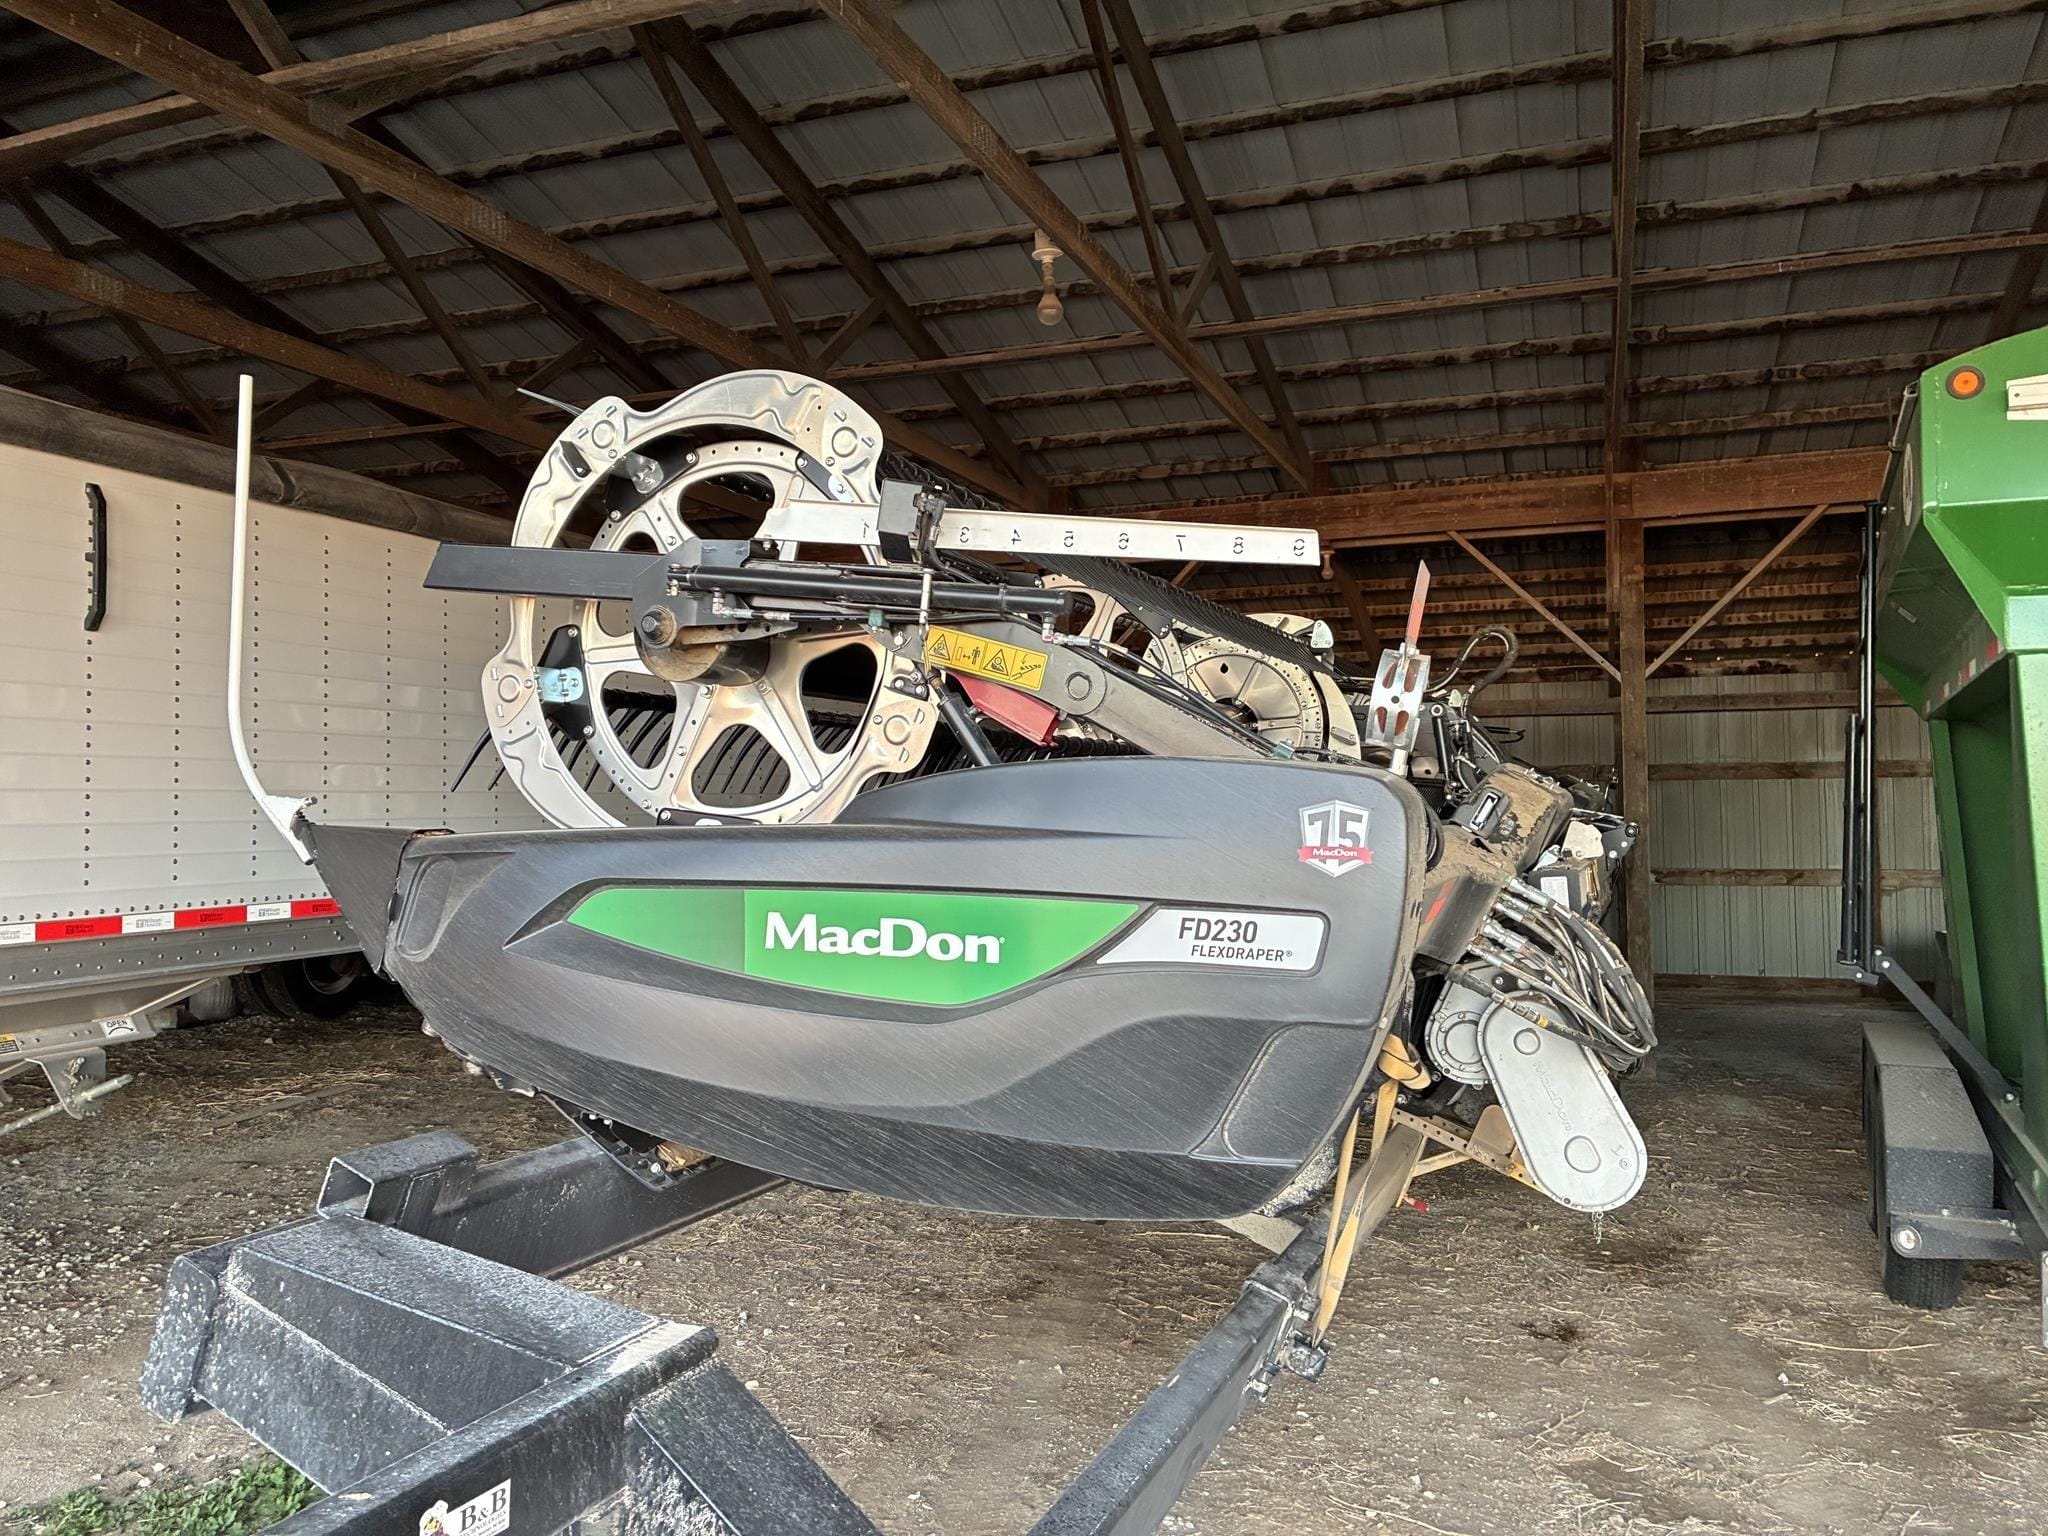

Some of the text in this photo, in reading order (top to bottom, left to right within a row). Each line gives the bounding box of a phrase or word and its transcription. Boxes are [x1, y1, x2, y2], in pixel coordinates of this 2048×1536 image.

[1312, 848, 1358, 857] MacDon
[765, 911, 1000, 964] MacDon
[1179, 917, 1258, 943] FD230
[106, 1019, 128, 1029] OPEN
